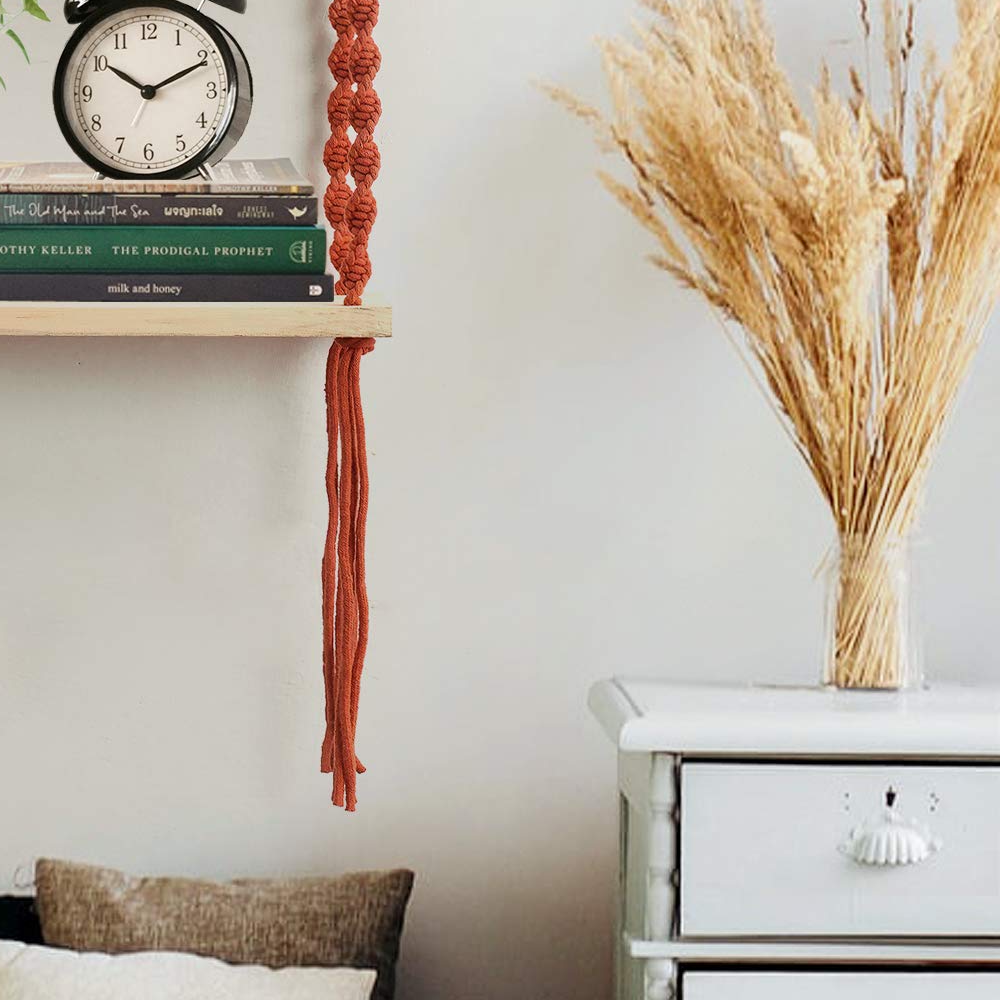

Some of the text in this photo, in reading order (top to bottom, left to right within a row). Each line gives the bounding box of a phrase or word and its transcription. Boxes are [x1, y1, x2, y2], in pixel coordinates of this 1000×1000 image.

[141, 23, 158, 41] 12
[175, 29, 181, 46] 1
[114, 33, 128, 50] 11
[93, 55, 109, 72] 10
[197, 49, 209, 67] 2
[81, 84, 93, 102] 9
[206, 81, 218, 100] 3
[91, 114, 102, 132] 8
[195, 111, 208, 129] 4
[115, 137, 126, 154] 7
[143, 142, 155, 161] 6
[175, 134, 186, 152] 5
[4, 202, 151, 223] The Old Man and The Sea
[41, 245, 93, 256] KELLER
[111, 245, 274, 257] THE PRODIGAL PROPHET
[107, 283, 183, 297] milk and honey
